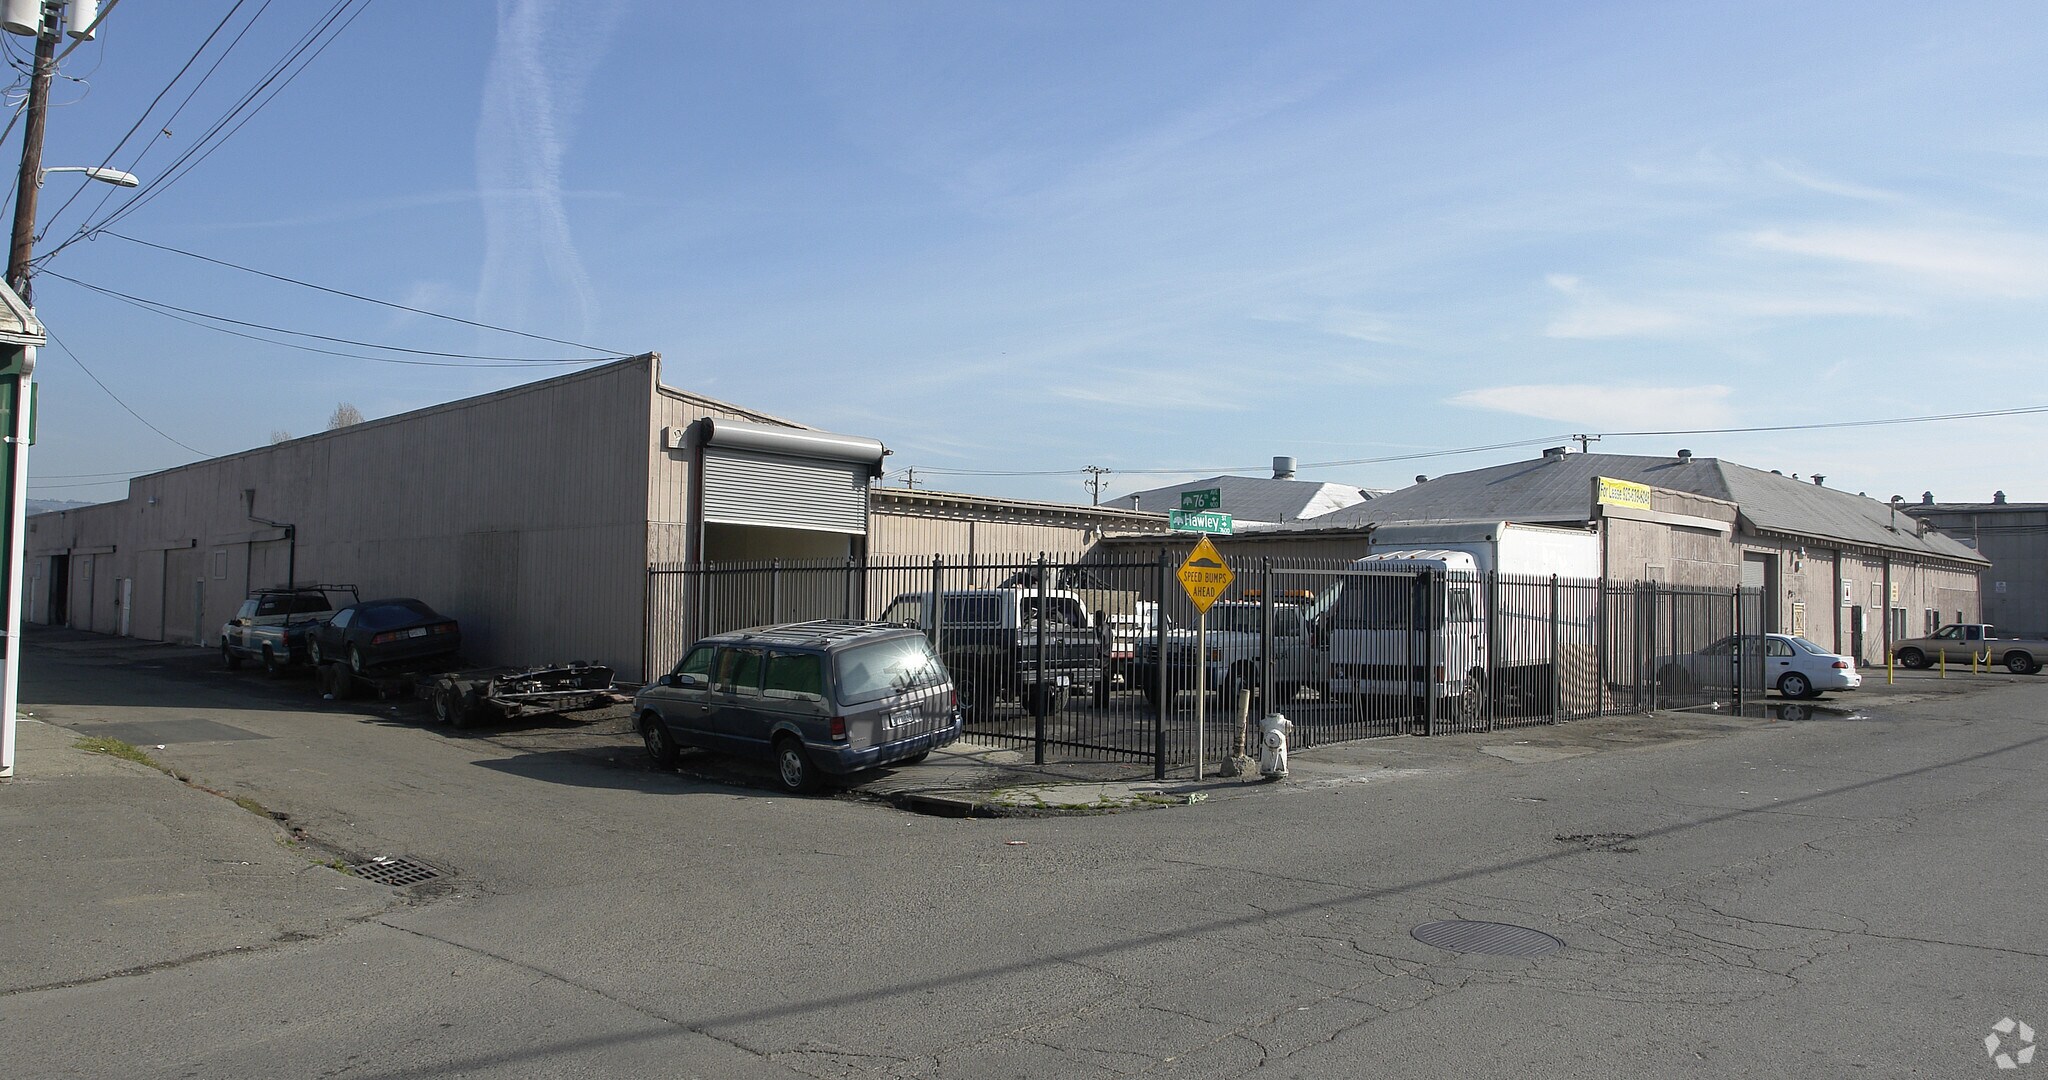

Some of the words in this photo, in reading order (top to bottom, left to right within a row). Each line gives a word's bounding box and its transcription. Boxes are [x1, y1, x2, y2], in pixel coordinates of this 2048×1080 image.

[1193, 494, 1205, 508] 76
[1184, 513, 1220, 532] Hawley
[1183, 571, 1202, 583] SPEED
[1205, 572, 1227, 584] BUMPS
[1192, 586, 1216, 598] AHEAD
